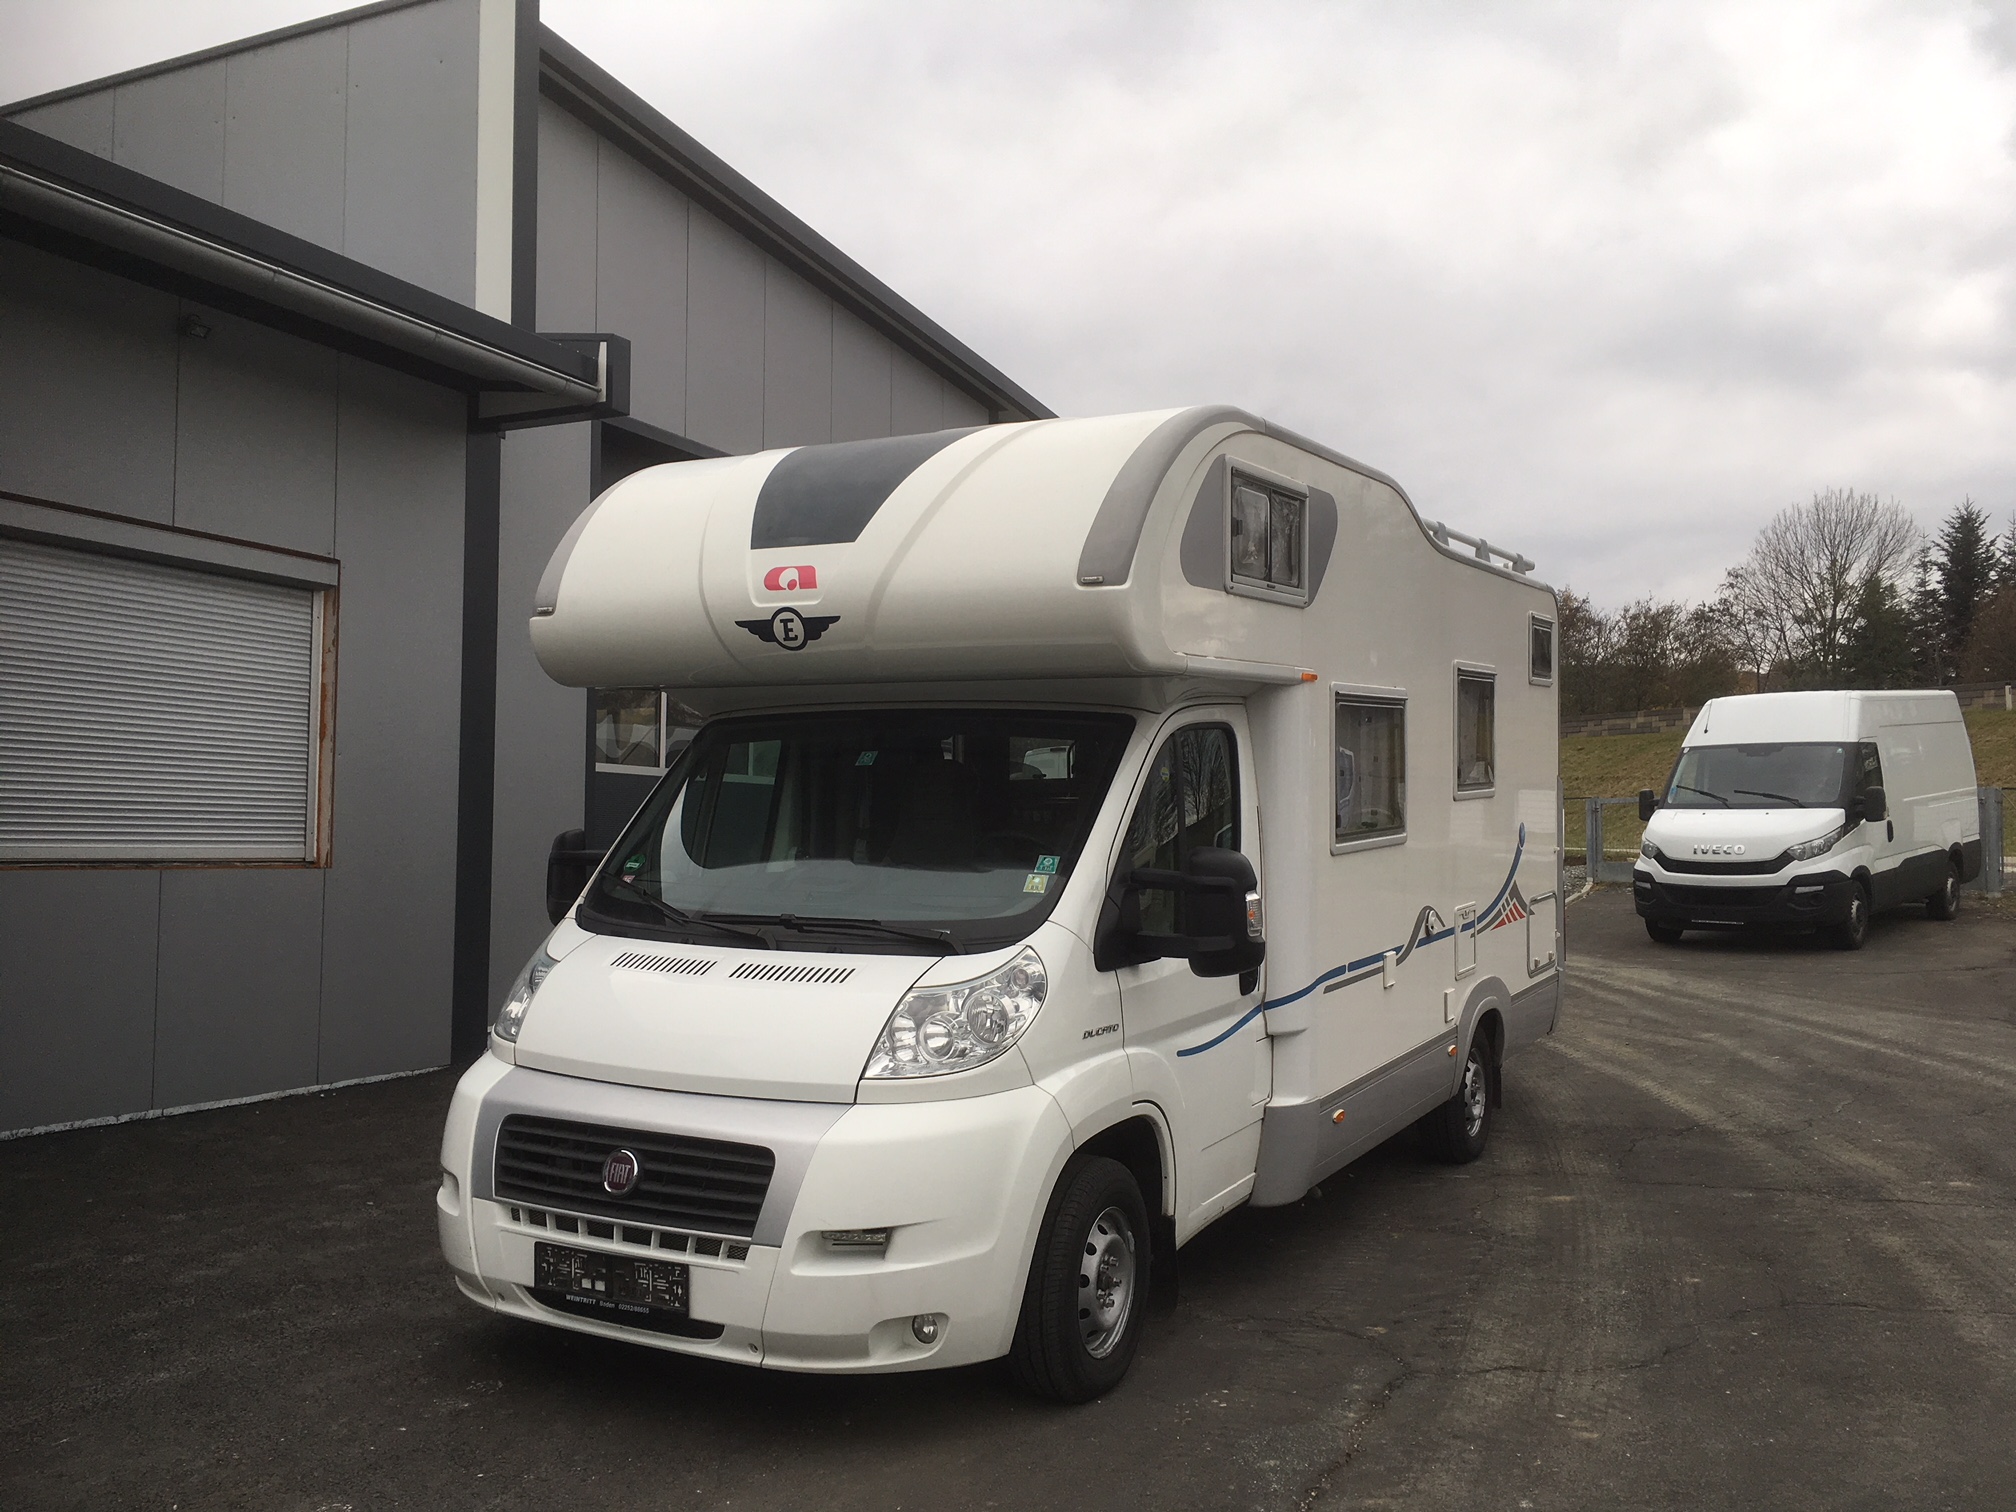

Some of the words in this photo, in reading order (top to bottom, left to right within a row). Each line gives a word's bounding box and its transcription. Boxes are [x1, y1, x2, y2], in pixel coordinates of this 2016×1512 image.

[779, 618, 799, 642] E
[1693, 844, 1746, 855] IVECO
[1082, 1023, 1120, 1040] DUCATO
[609, 1163, 631, 1184] FIAT
[565, 1294, 597, 1305] WEINTRITT
